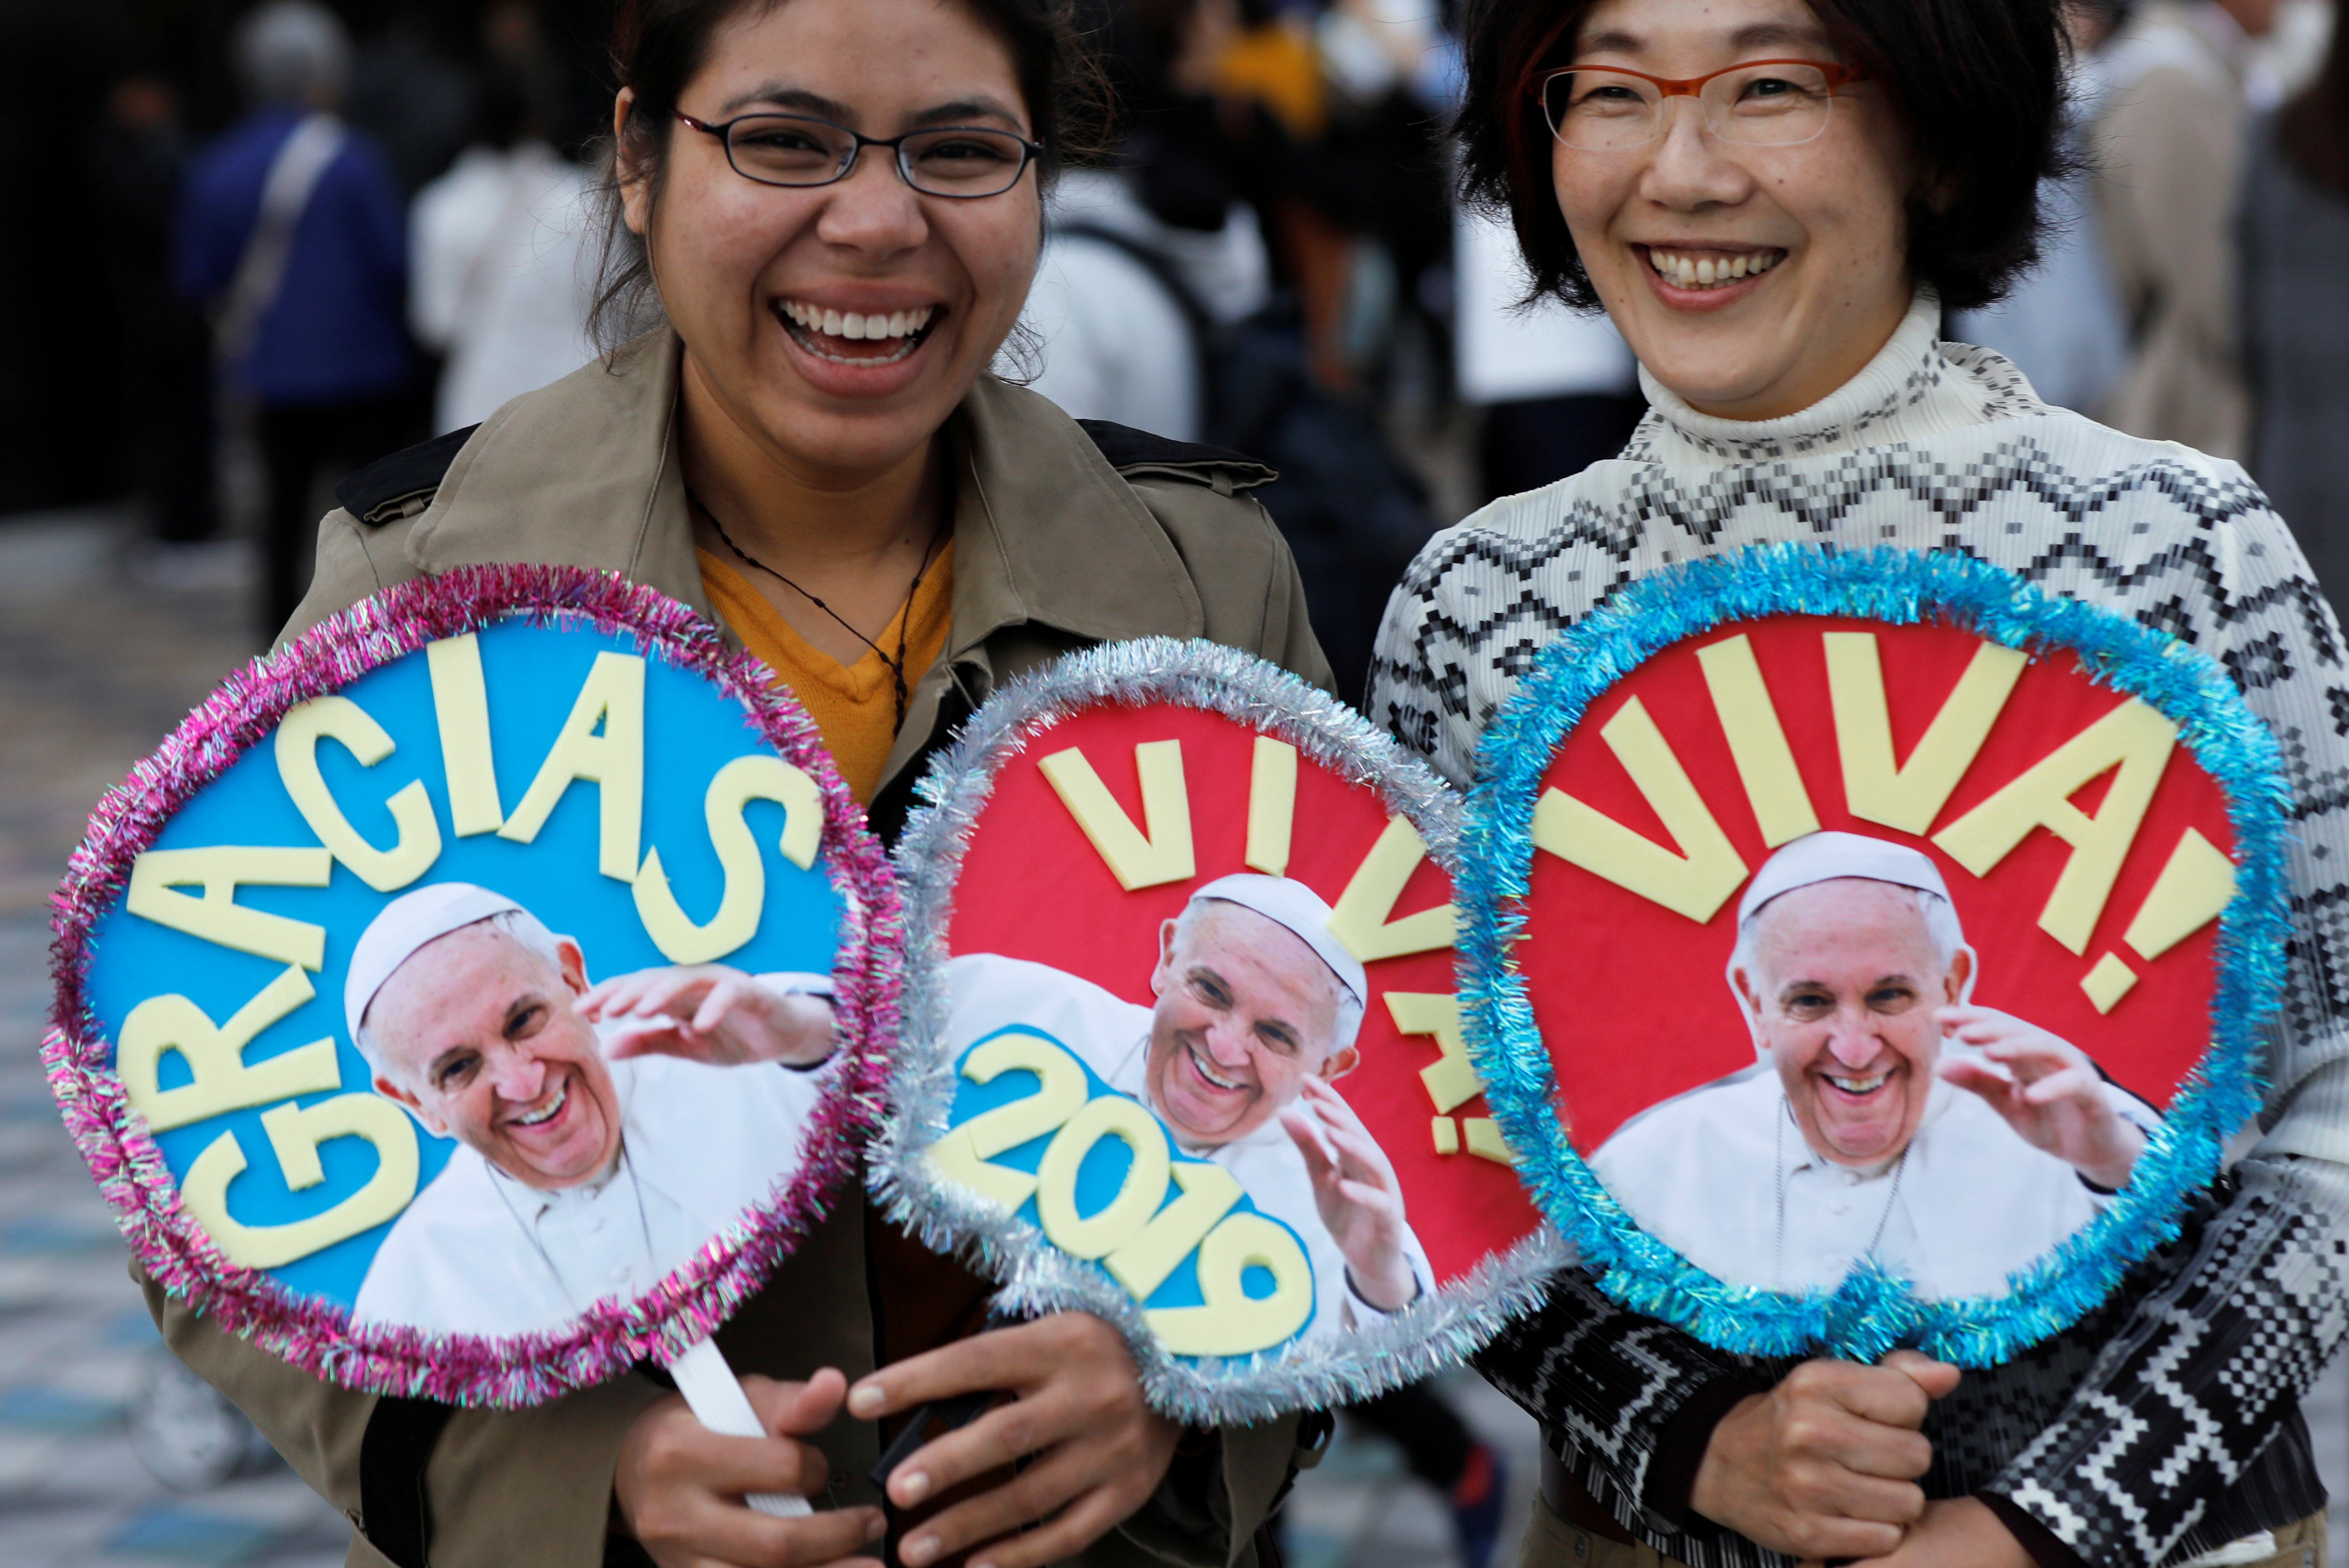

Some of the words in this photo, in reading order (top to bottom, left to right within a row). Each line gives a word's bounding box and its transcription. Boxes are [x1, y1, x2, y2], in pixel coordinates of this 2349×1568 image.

[116, 631, 824, 1268] GRACIAS
[1533, 631, 2238, 1015] VIVA!
[927, 1032, 1314, 1356] 2019
